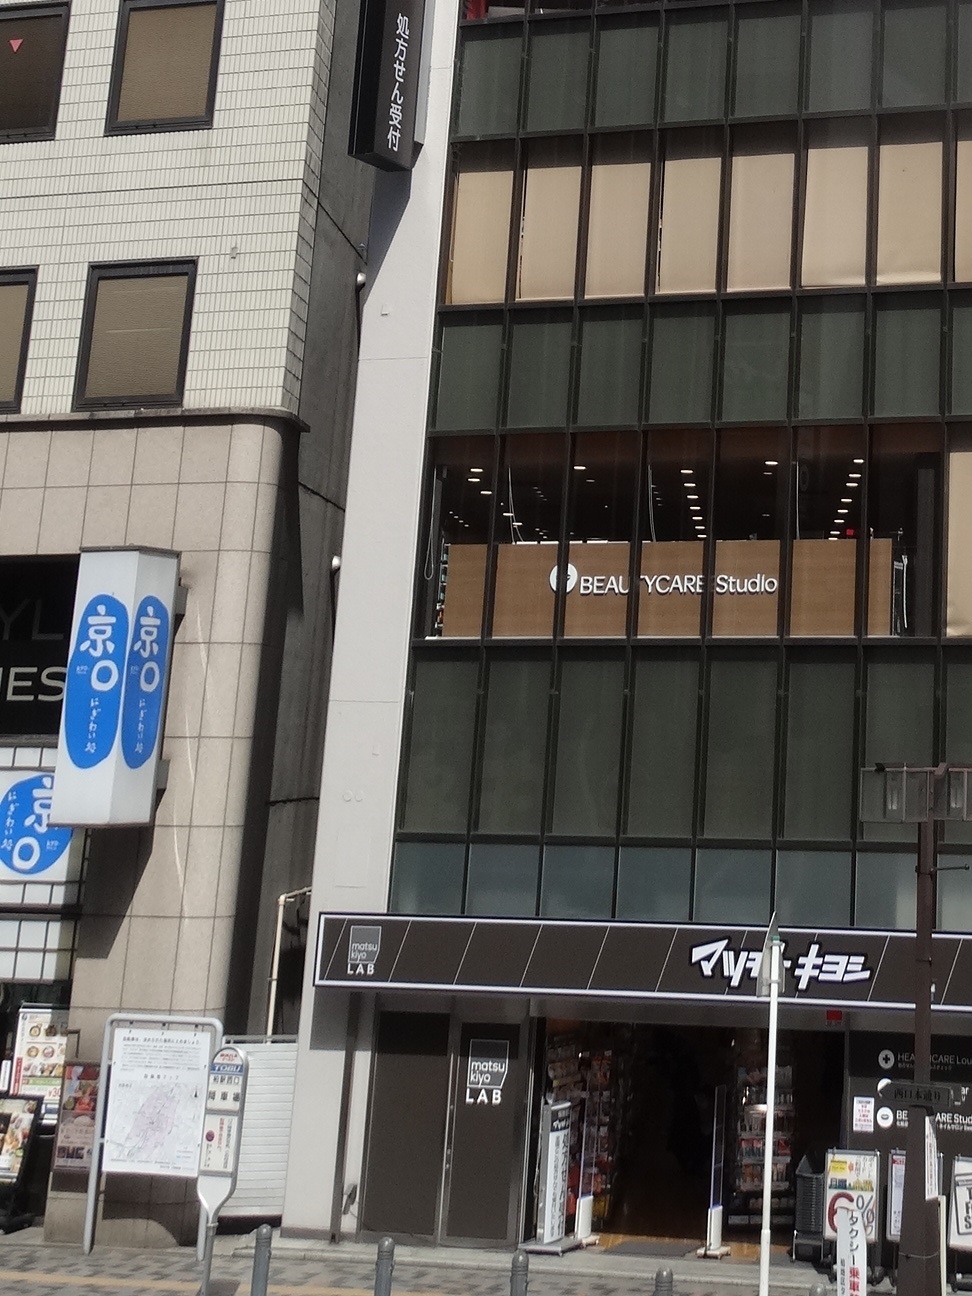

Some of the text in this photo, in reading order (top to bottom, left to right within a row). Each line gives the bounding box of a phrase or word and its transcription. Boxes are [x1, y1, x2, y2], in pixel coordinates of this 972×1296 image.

[387, 13, 410, 152] 処方せん受付
[715, 573, 779, 595] Studio
[352, 942, 378, 951] matsu
[351, 951, 367, 962] kiyo
[347, 963, 375, 976] LAB
[471, 1060, 505, 1072] matsu
[470, 1070, 491, 1086] kiyo
[465, 1088, 502, 1105] LAB
